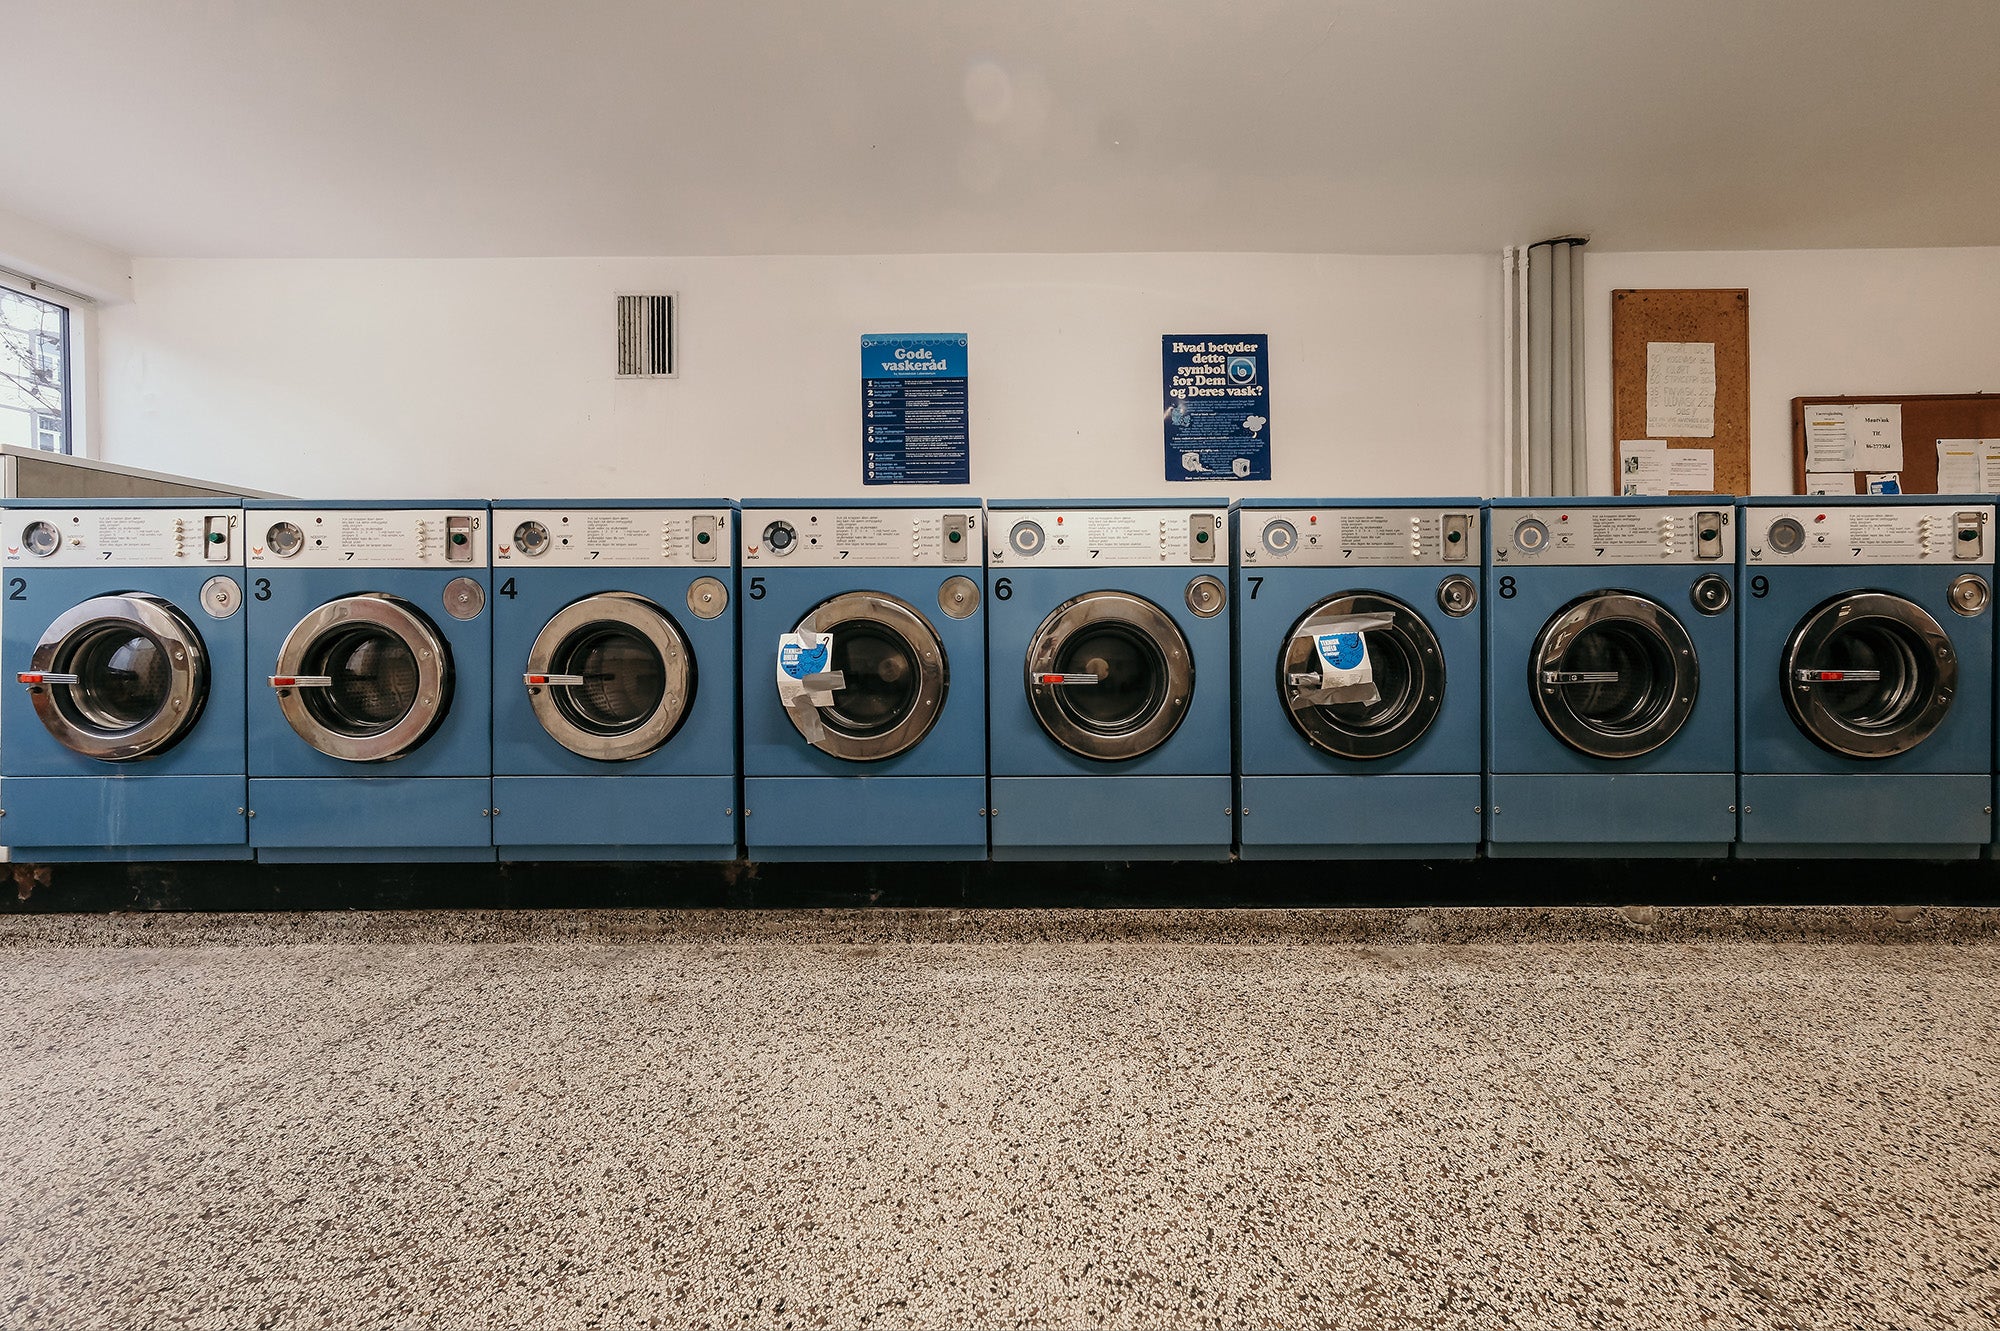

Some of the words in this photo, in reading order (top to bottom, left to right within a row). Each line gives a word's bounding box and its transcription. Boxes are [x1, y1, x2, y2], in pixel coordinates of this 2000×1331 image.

[895, 349, 932, 359] Gode
[1173, 343, 1205, 353] Hvad
[1208, 343, 1258, 354] betyder
[1192, 354, 1225, 363] dette
[882, 359, 947, 371] vaskeråd
[1178, 365, 1226, 375] symbol
[1173, 376, 1193, 386] for
[1195, 376, 1226, 385] Dem
[867, 389, 874, 397] 2
[1170, 388, 1186, 398] og
[1188, 387, 1225, 396] Deres
[1227, 386, 1263, 396] vask?
[867, 400, 874, 408] 3
[868, 426, 874, 434] 5
[868, 471, 875, 479] 9
[230, 516, 237, 527] 2
[473, 517, 480, 529] 3
[718, 516, 725, 528] 4
[968, 516, 975, 529] 5
[1215, 516, 1222, 528] 6
[1722, 513, 1729, 525] 8
[1981, 512, 1988, 525] 9
[102, 552, 112, 560] 7
[840, 551, 849, 559] 7
[1090, 550, 1099, 558] 7
[1343, 550, 1353, 558] 7
[1851, 548, 1862, 556] 7
[9, 578, 27, 600] 2
[254, 578, 272, 601] 3
[499, 577, 518, 599] 4
[749, 577, 766, 600] 5
[994, 577, 1012, 600] 6
[1247, 577, 1264, 599] 7
[1499, 575, 1517, 599] 8
[1751, 575, 1770, 598] 9
